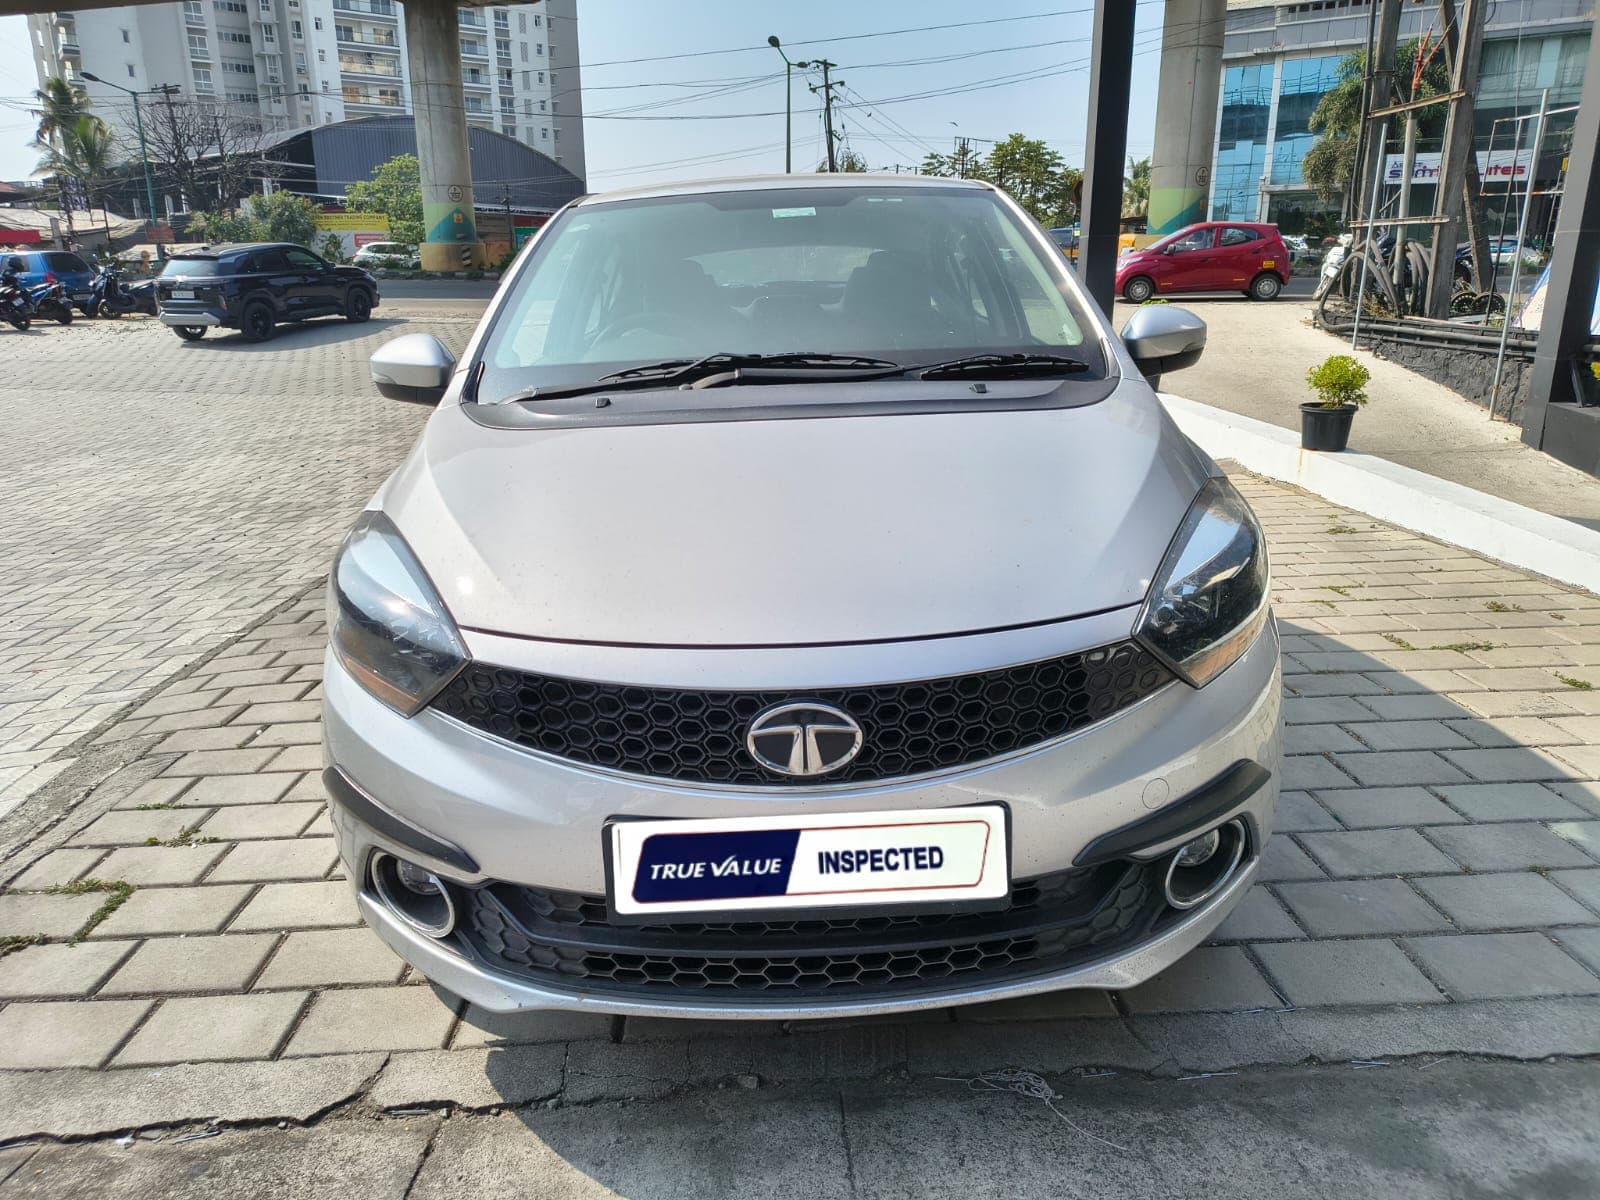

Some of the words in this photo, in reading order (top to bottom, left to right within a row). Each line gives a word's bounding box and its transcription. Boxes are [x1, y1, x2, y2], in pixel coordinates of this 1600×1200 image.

[650, 862, 706, 880] TRUE
[710, 854, 782, 877] VALUE
[818, 846, 944, 875] INSPECTED
